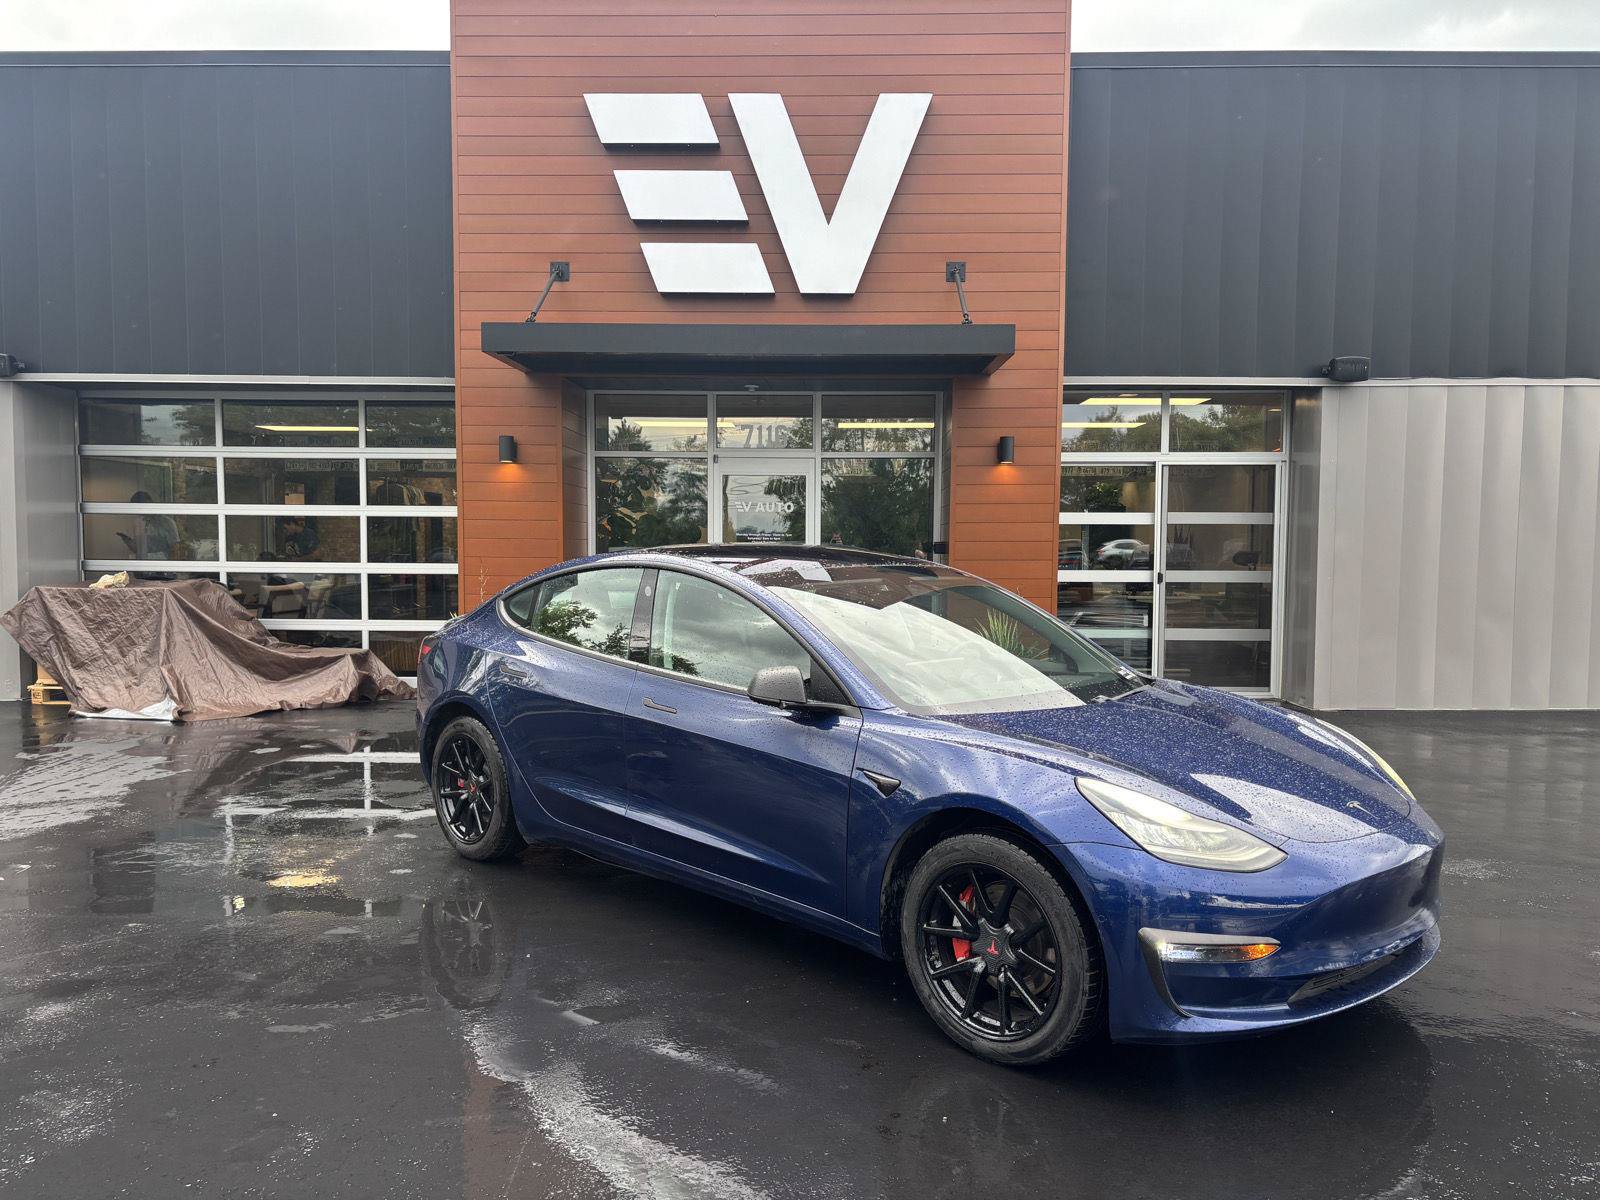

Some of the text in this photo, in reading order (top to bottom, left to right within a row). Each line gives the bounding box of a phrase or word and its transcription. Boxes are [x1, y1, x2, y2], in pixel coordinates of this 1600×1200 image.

[583, 92, 933, 295] EV
[734, 501, 795, 513] EV AUTO
